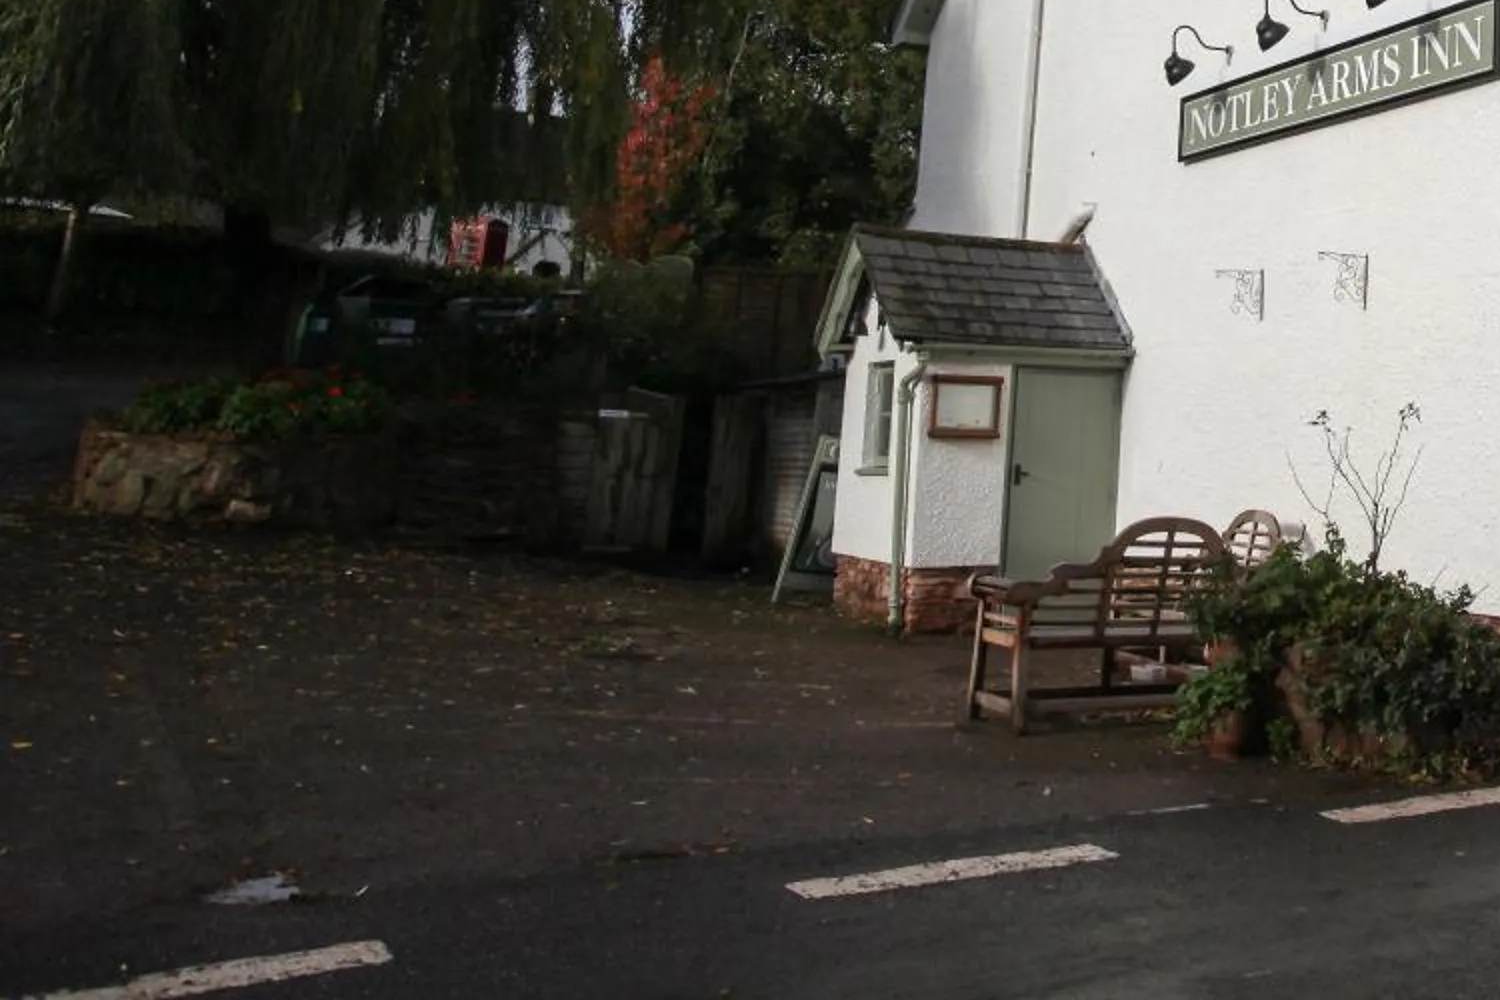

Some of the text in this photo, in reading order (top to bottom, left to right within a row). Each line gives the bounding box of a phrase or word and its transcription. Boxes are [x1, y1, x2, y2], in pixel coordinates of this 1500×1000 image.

[1188, 17, 1486, 143] NOTLEY ARMS INN
